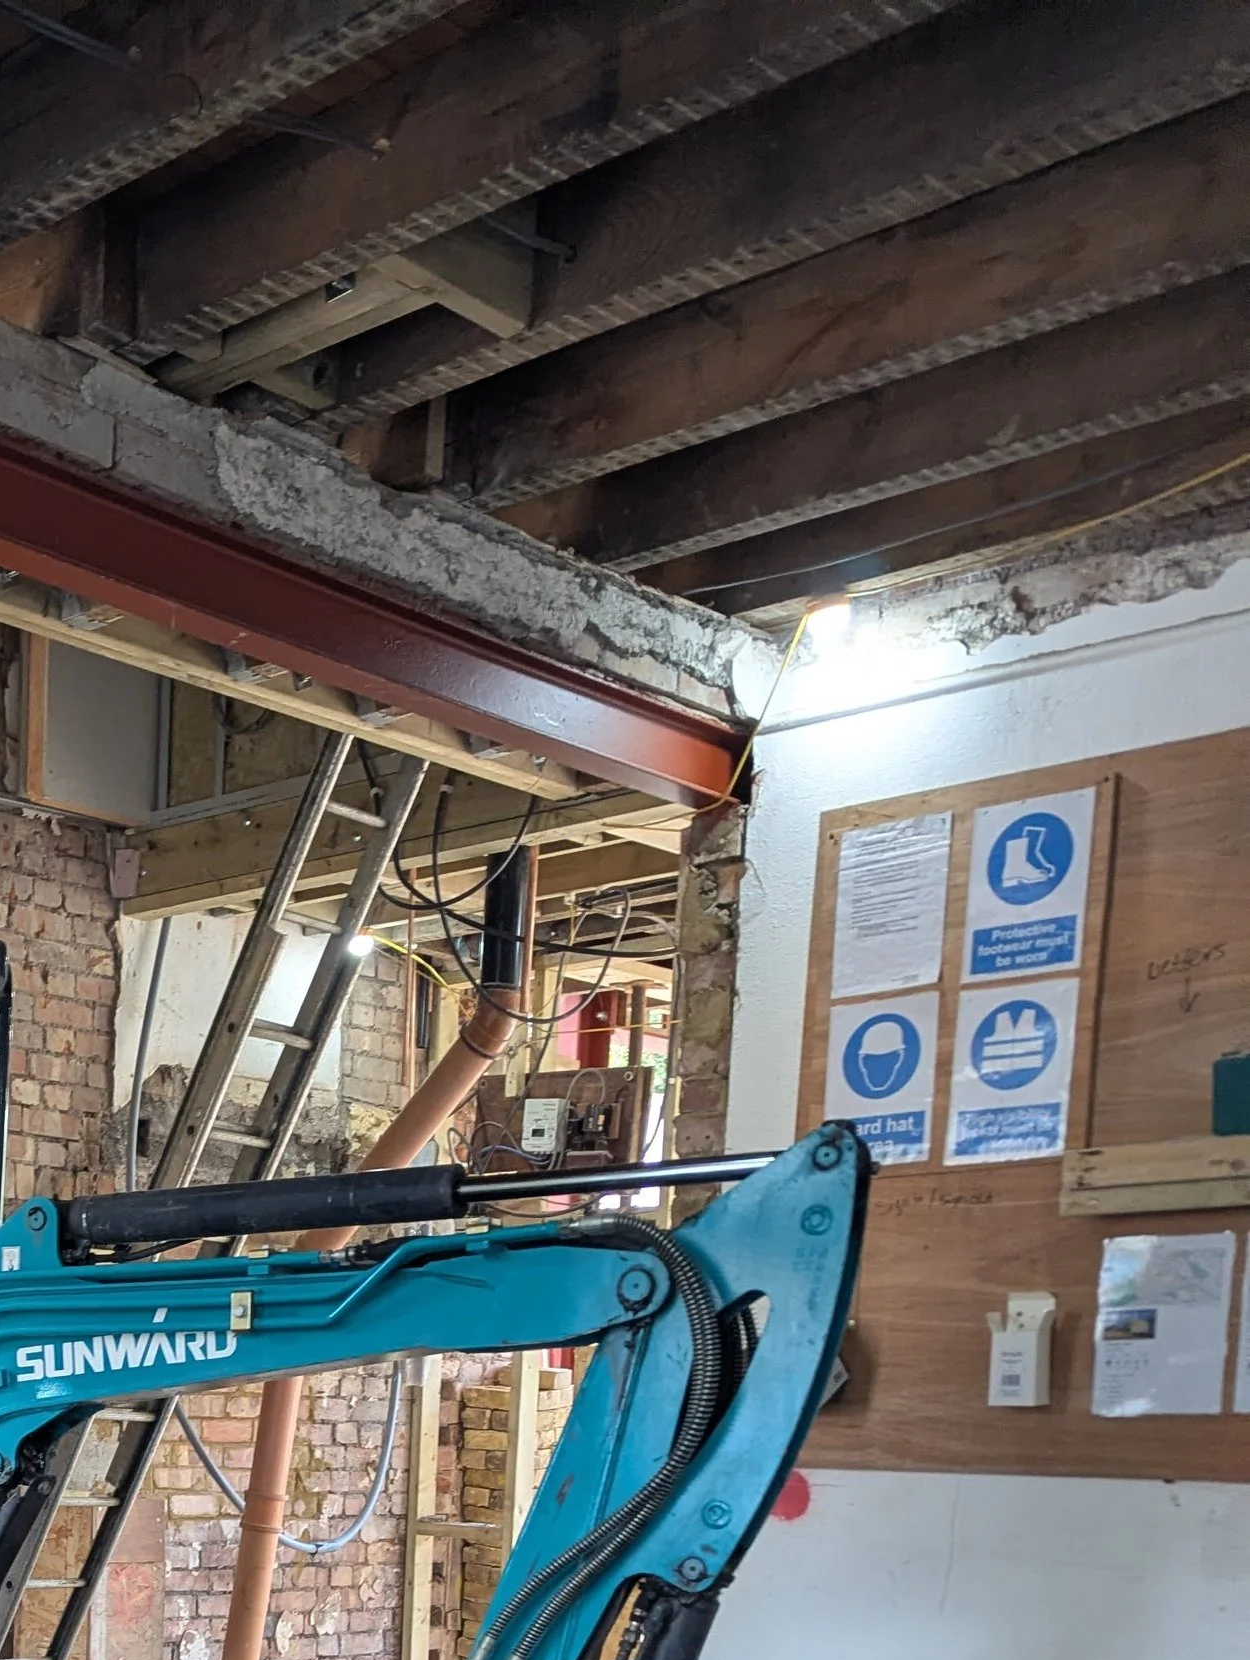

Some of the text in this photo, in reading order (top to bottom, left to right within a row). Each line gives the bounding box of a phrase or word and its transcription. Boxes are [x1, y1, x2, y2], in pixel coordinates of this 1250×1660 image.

[990, 923, 1056, 941] Protective
[977, 933, 1070, 956] footwear must
[995, 952, 1048, 967] be worn
[855, 1116, 914, 1136] ard hat
[868, 1140, 895, 1153] rea
[16, 1308, 238, 1382] SUNWARD
